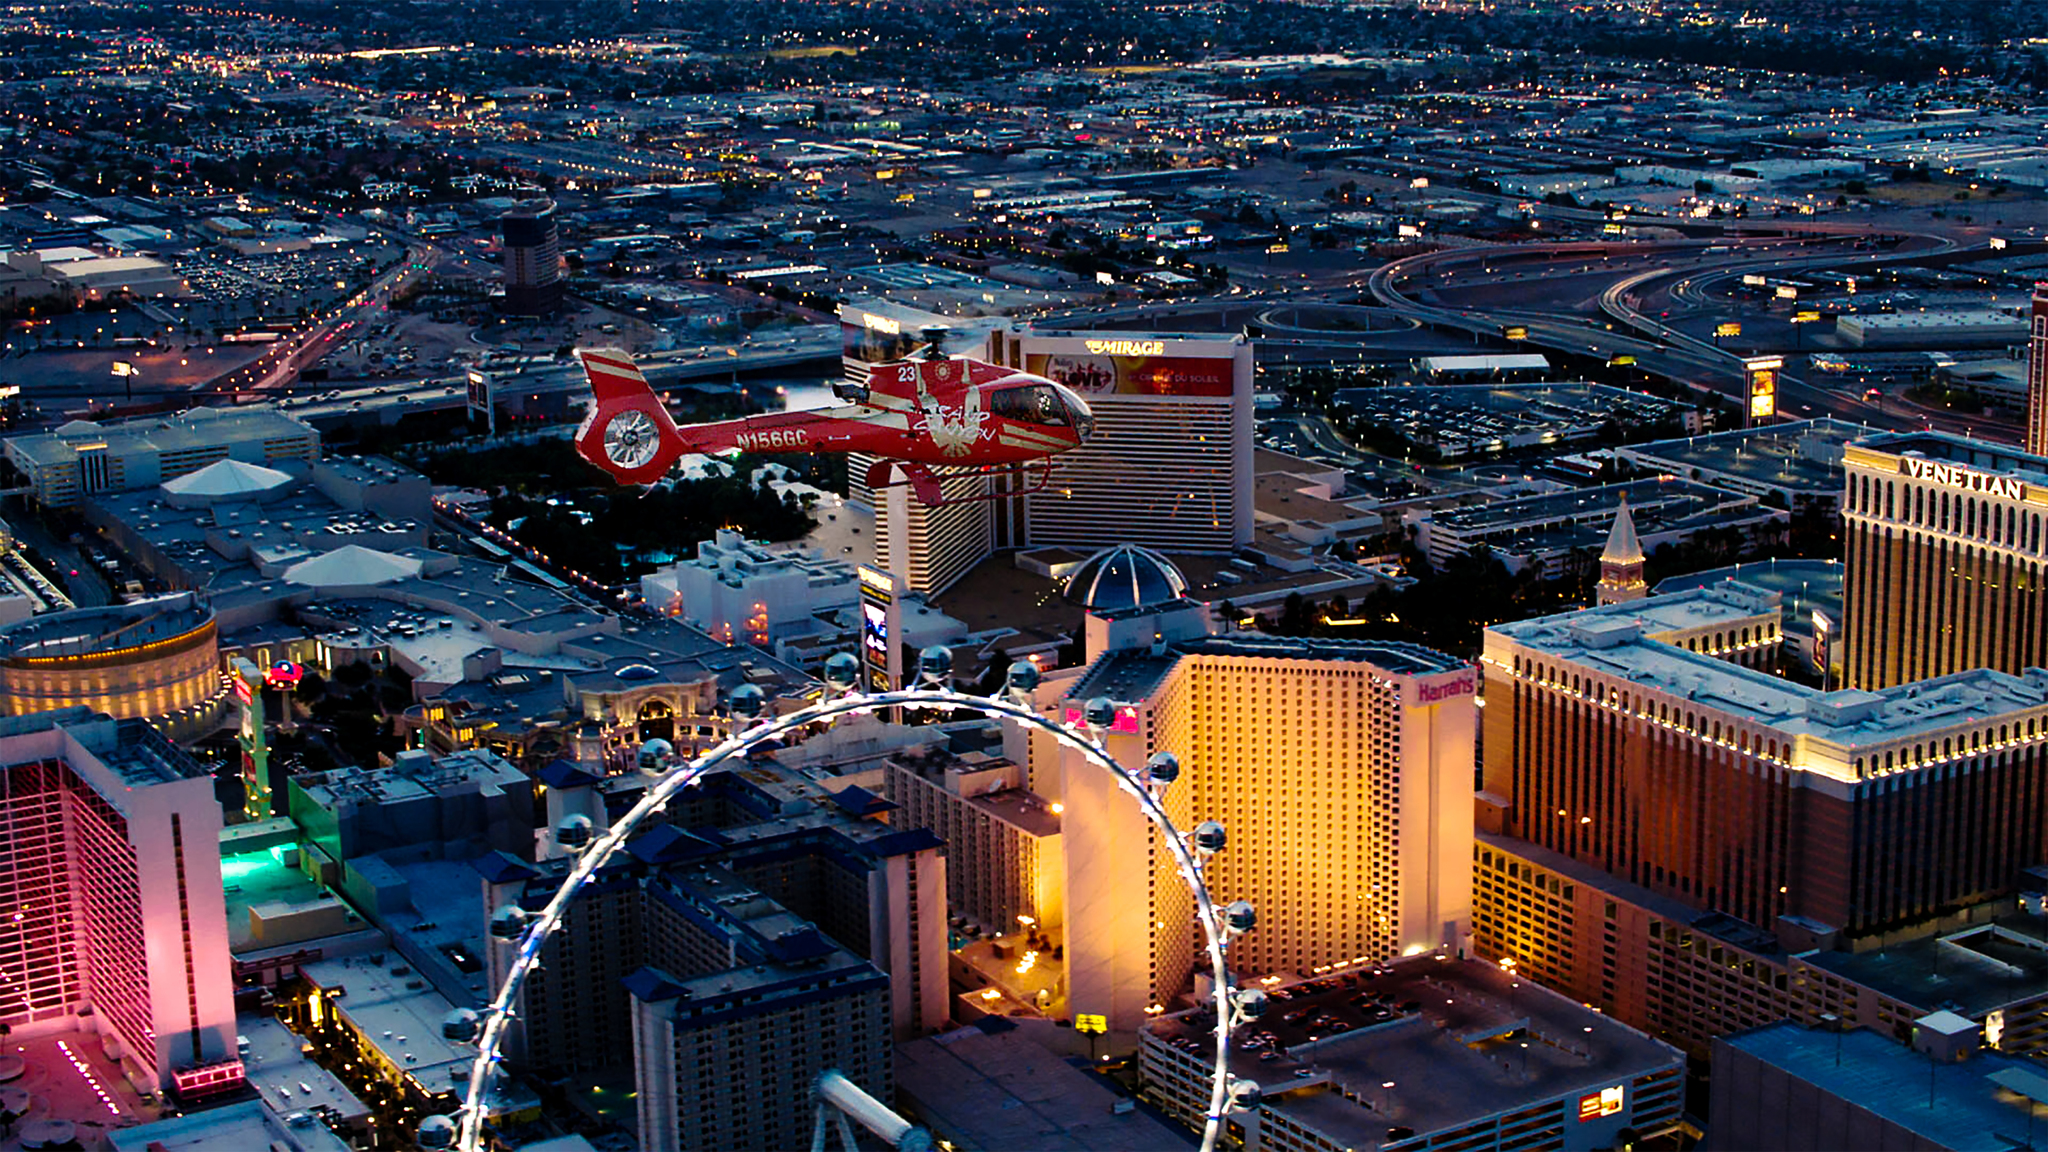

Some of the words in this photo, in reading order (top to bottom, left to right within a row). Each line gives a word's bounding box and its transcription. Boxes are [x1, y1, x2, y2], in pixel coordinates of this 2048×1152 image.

[1091, 340, 1164, 357] MIRAGE
[898, 366, 915, 382] 23
[736, 429, 808, 450] N156GC
[1905, 458, 2023, 501] VENETIAN
